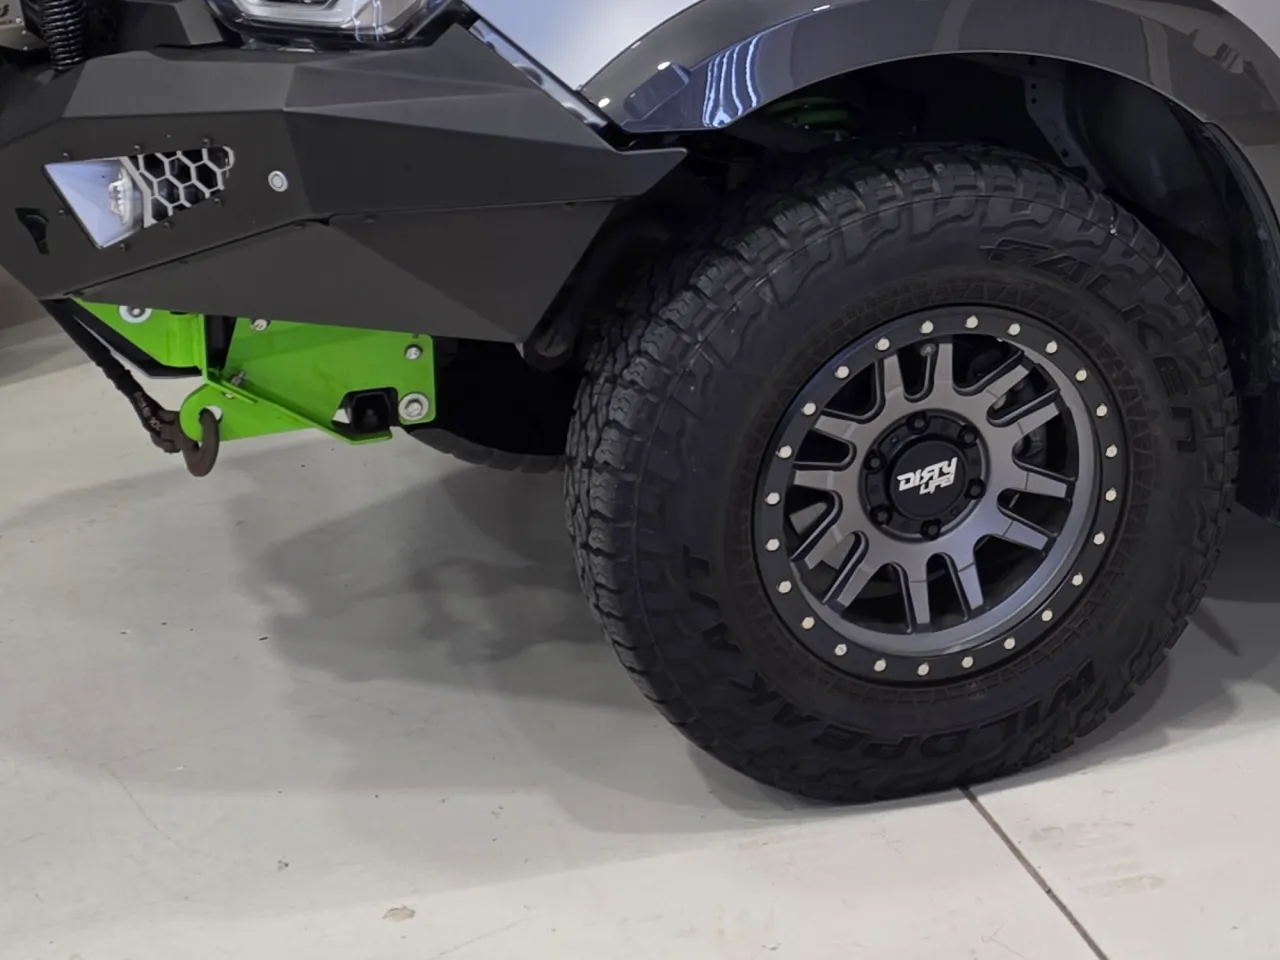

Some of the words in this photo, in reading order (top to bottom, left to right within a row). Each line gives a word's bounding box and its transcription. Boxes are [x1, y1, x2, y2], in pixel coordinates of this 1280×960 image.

[978, 236, 1198, 454] FALKEN
[896, 457, 958, 491] DIRTY
[727, 654, 1096, 760] WILDPEAK
